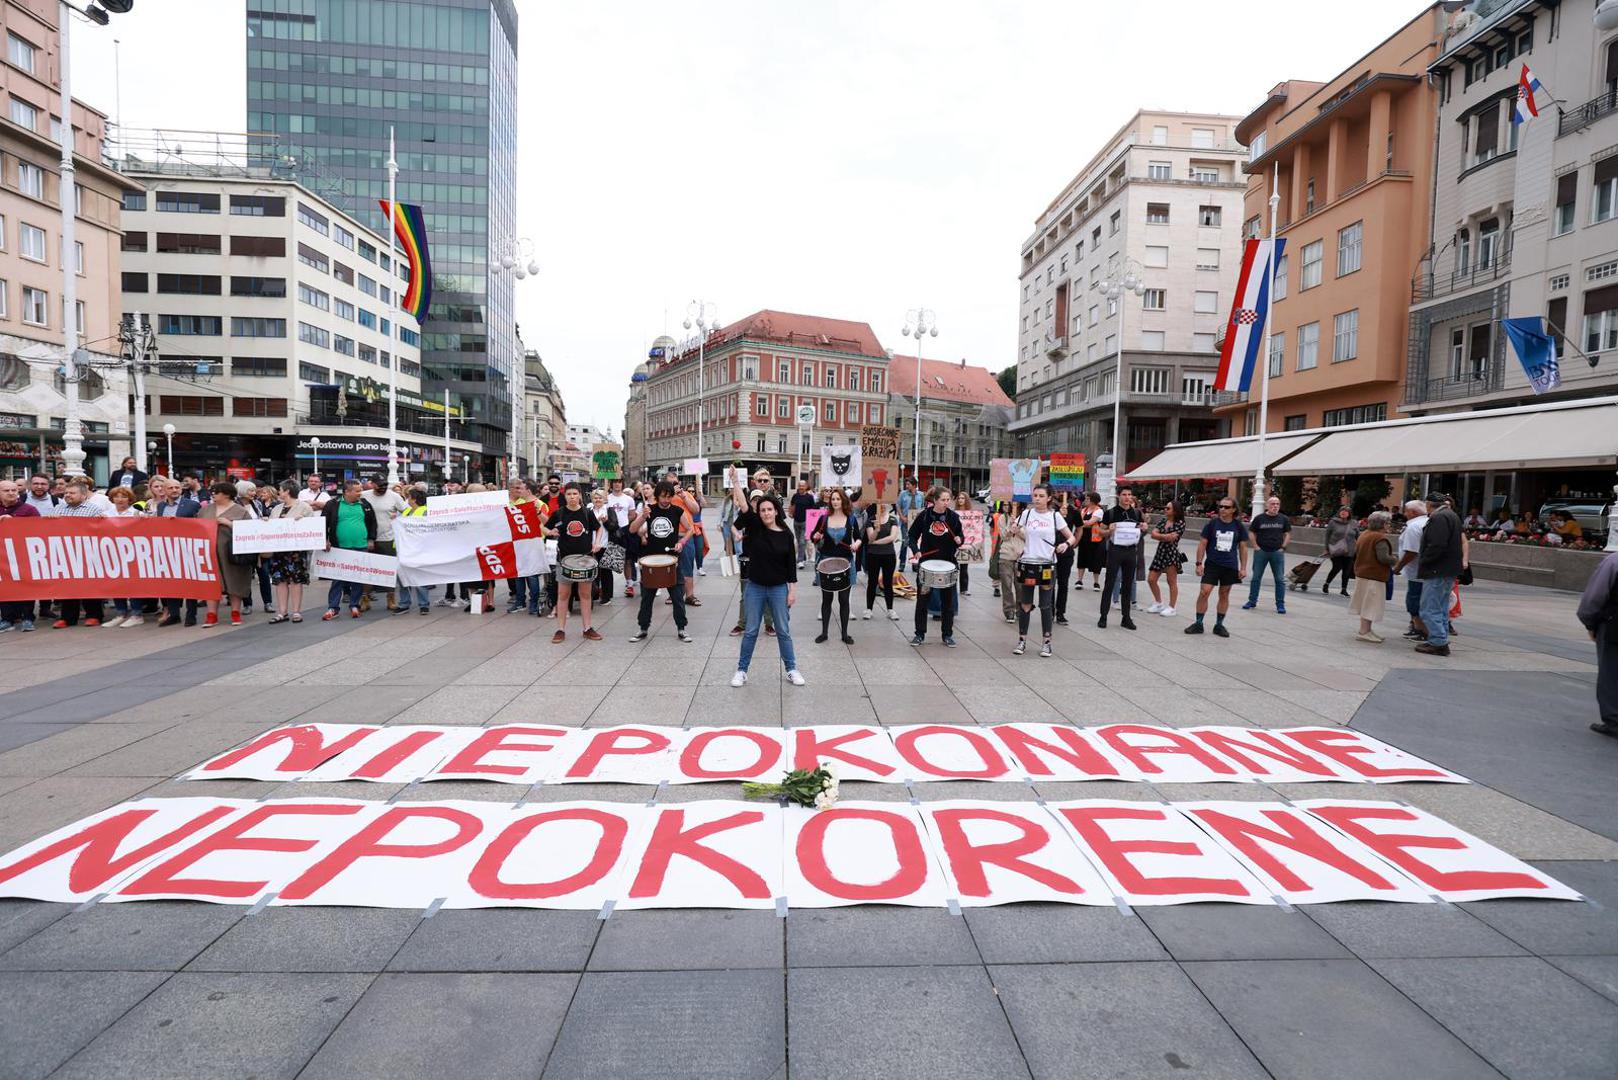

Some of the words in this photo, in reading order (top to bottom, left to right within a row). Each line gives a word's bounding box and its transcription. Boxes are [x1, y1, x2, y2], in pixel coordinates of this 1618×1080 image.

[297, 440, 353, 450] Jedostavno
[356, 442, 379, 451] puno
[507, 505, 531, 535] SDP
[4, 538, 21, 581] I
[25, 536, 217, 581] RAVNOPRAVNE!
[480, 545, 505, 576] SDP
[204, 725, 1451, 779] NIEPOKONANE
[0, 804, 1549, 900] NEPOKORENE
